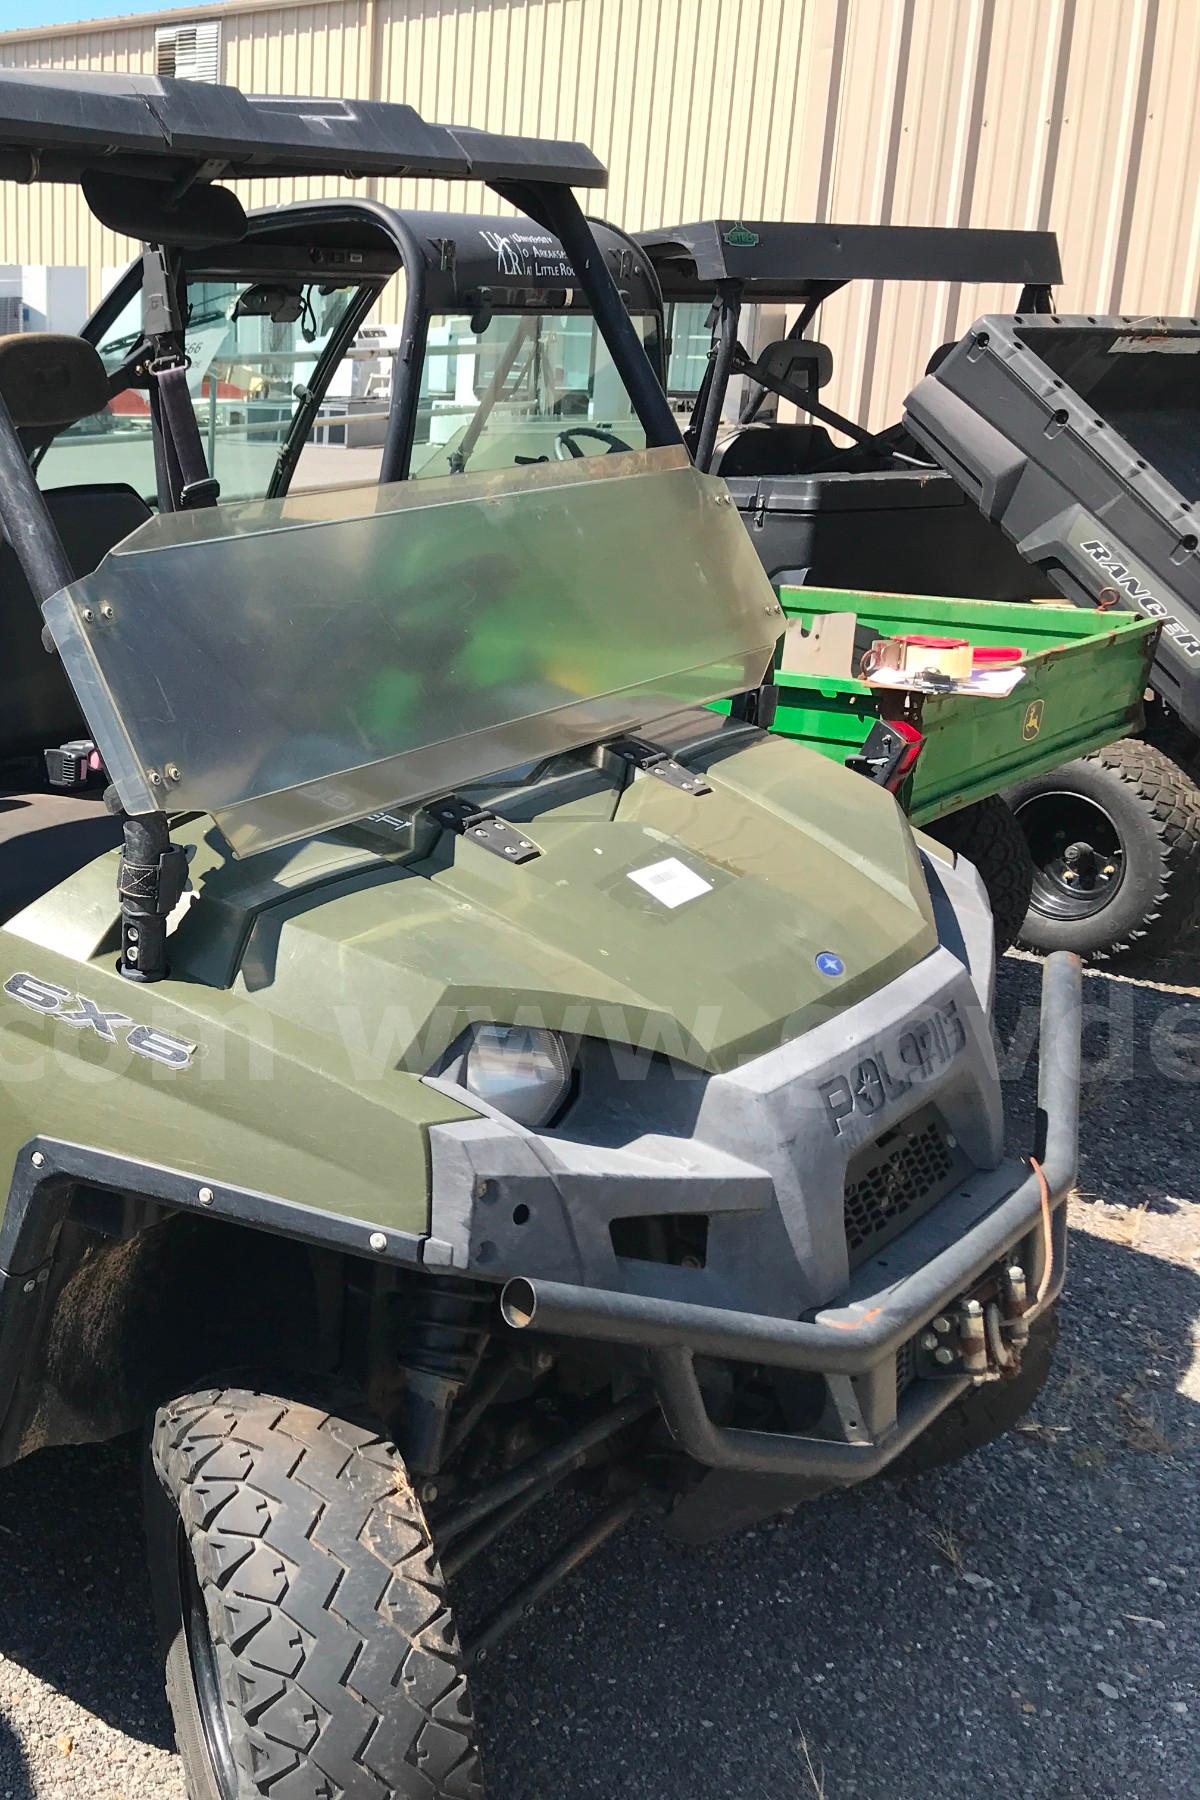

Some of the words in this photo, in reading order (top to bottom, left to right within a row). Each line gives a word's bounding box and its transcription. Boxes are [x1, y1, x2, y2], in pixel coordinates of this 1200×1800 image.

[533, 245, 568, 259] ARKANSA
[560, 262, 576, 276] ROC
[1080, 540, 1200, 657] RANGER
[818, 1000, 967, 1137] POLARIS
